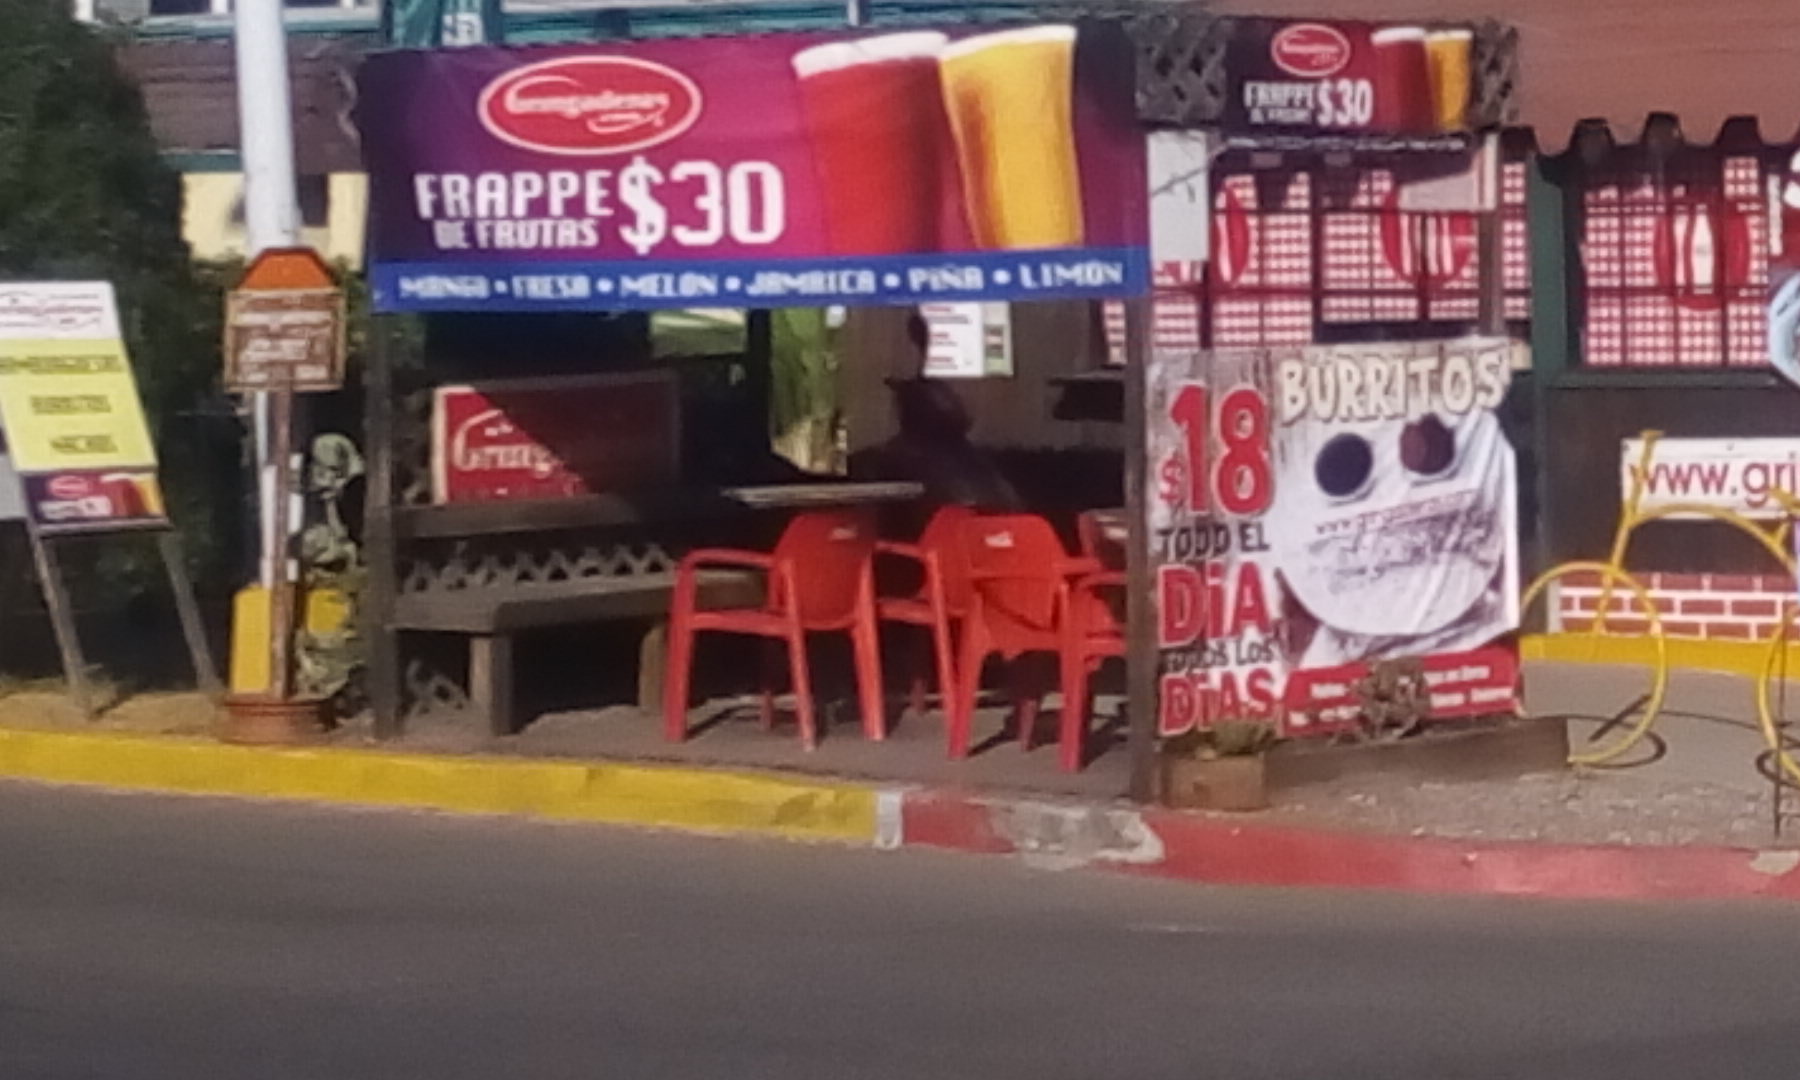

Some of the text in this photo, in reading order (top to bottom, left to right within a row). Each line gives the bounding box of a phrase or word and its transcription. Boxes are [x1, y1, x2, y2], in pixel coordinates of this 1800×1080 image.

[413, 170, 614, 219] FRAPPE
[617, 155, 785, 255] $30
[475, 219, 600, 250] FRUTAS
[1278, 348, 1503, 427] BURRITOS
[1238, 522, 1270, 552] EL
